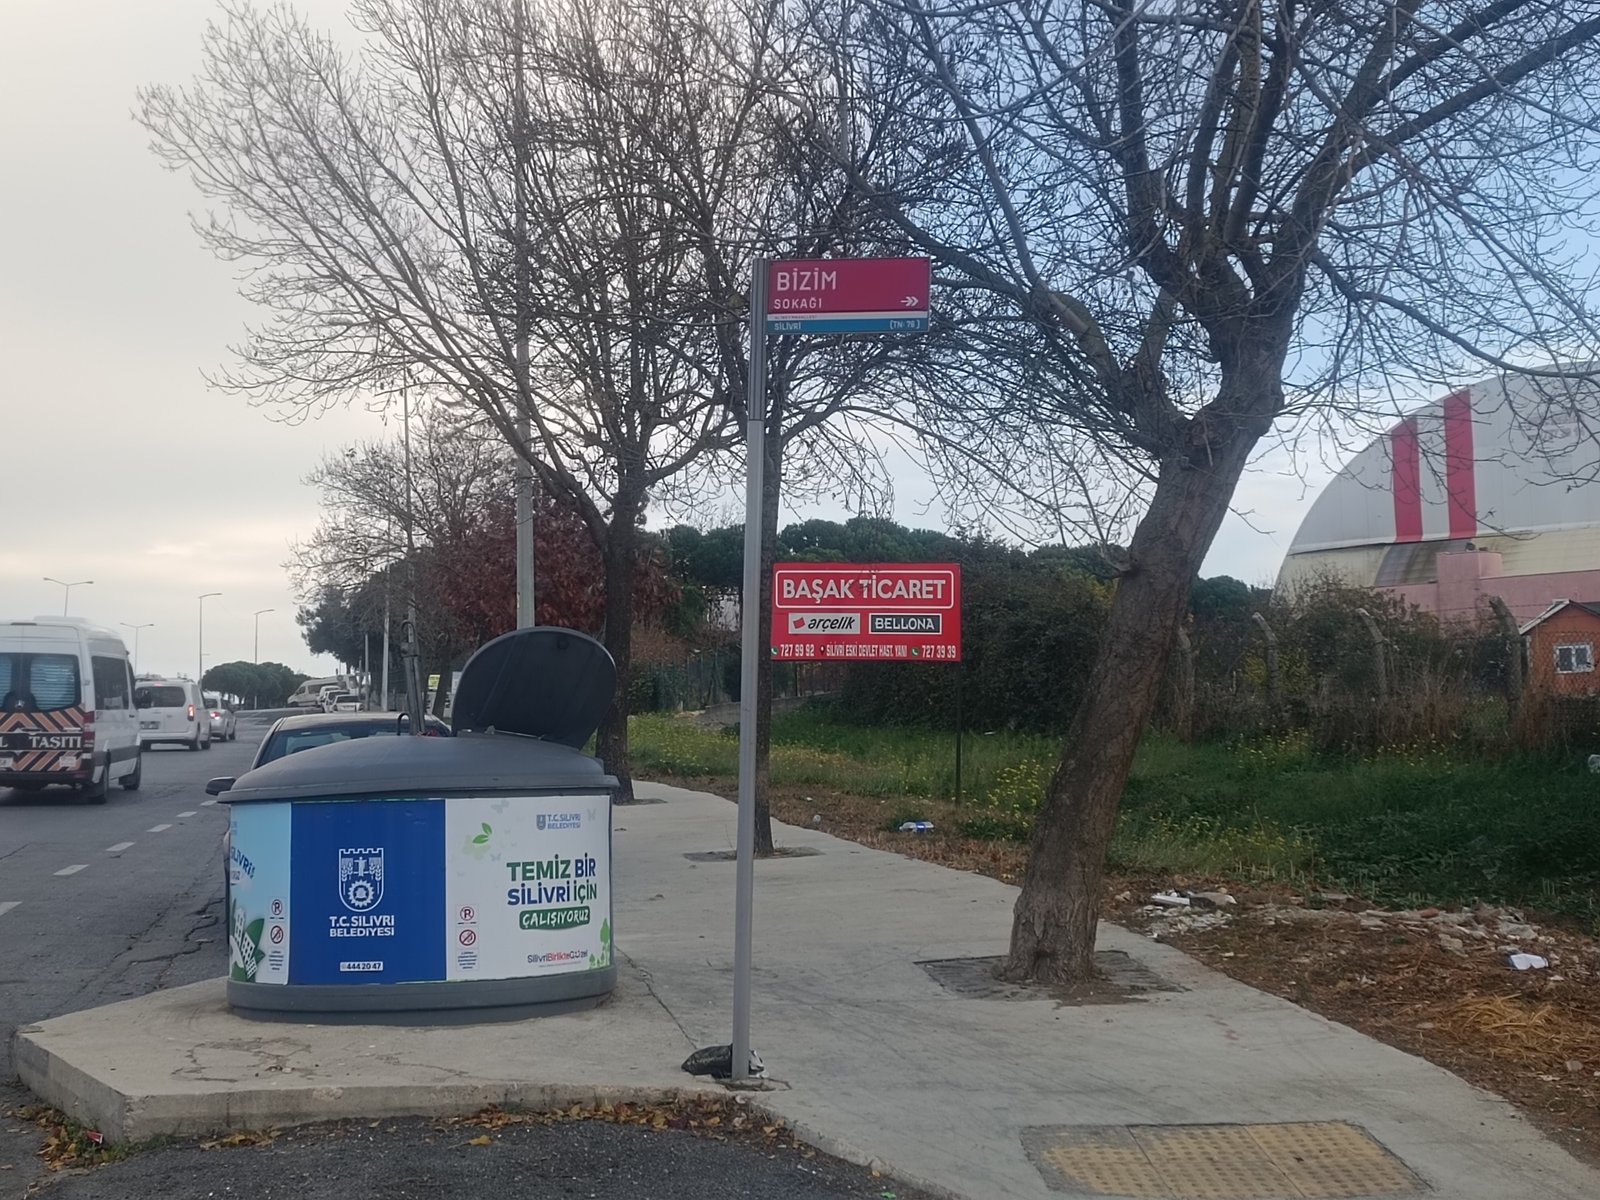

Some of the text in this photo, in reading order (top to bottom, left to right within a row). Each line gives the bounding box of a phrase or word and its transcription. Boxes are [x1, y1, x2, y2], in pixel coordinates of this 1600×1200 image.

[777, 268, 837, 291] BİZİM
[774, 297, 822, 310] SOKAĞI
[783, 574, 946, 604] BAŞAK TİCARET
[808, 616, 935, 632] arçelik BELLONA
[780, 644, 815, 657] 727 99 92
[922, 645, 957, 659] 727 39 39
[506, 852, 596, 882] TEMİZ BİR
[507, 879, 597, 906] SİLİVRİ İÇİN
[329, 916, 350, 927] T.C.
[522, 908, 589, 928] ÇALIŞIYORUZ
[347, 962, 382, 970] 444 20 47
